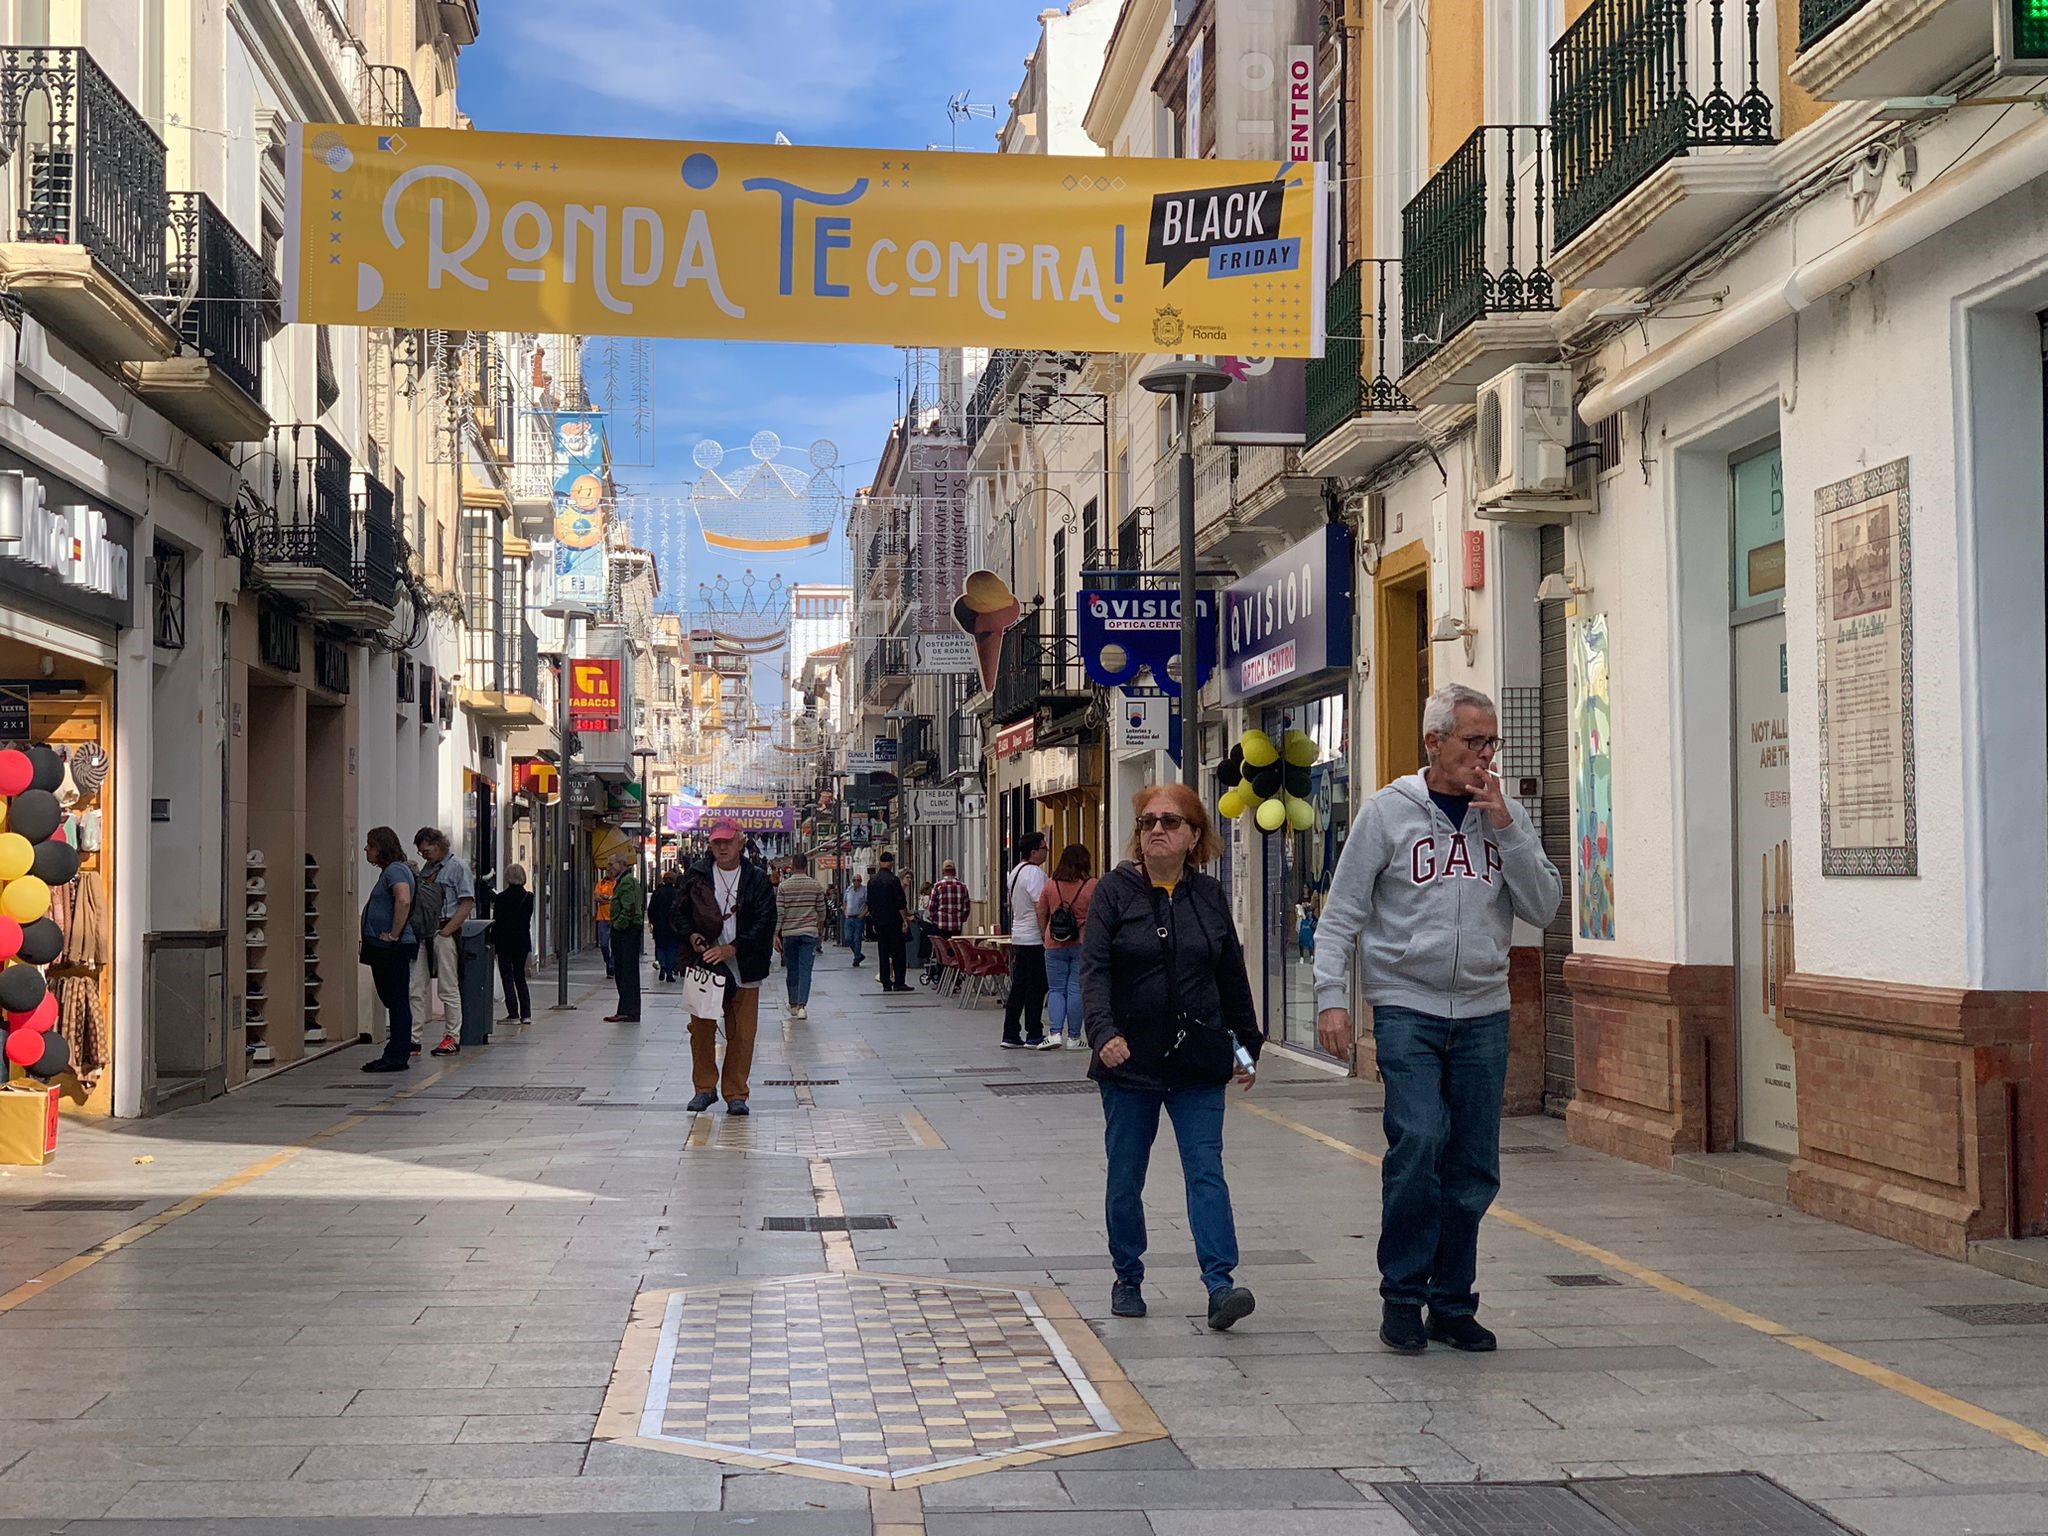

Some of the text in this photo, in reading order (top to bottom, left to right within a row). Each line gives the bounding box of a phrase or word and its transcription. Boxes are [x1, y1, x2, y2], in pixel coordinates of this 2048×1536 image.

[1291, 60, 1310, 161] ENTRO
[1162, 190, 1268, 246] BLACK
[382, 164, 1124, 323] RONDA TE COMPRA!
[1219, 246, 1291, 271] FRIDAY
[1193, 329, 1227, 340] Ronda
[1471, 536, 1481, 568] FRIGO
[1108, 621, 1182, 630] OPTICA CENTR
[1242, 644, 1295, 687] OPTICA CENTRO
[568, 698, 616, 707] TABACOS
[3, 721, 9, 729] 2
[19, 721, 24, 729] 1
[1751, 717, 1788, 743] NOT ALL
[1760, 744, 1790, 771] ARE TH
[569, 781, 588, 789] UNT
[925, 790, 954, 798] THE BACK
[699, 809, 784, 818] POR UN FUTURO
[700, 818, 783, 829] FENISTA
[1411, 833, 1501, 886] GAP
